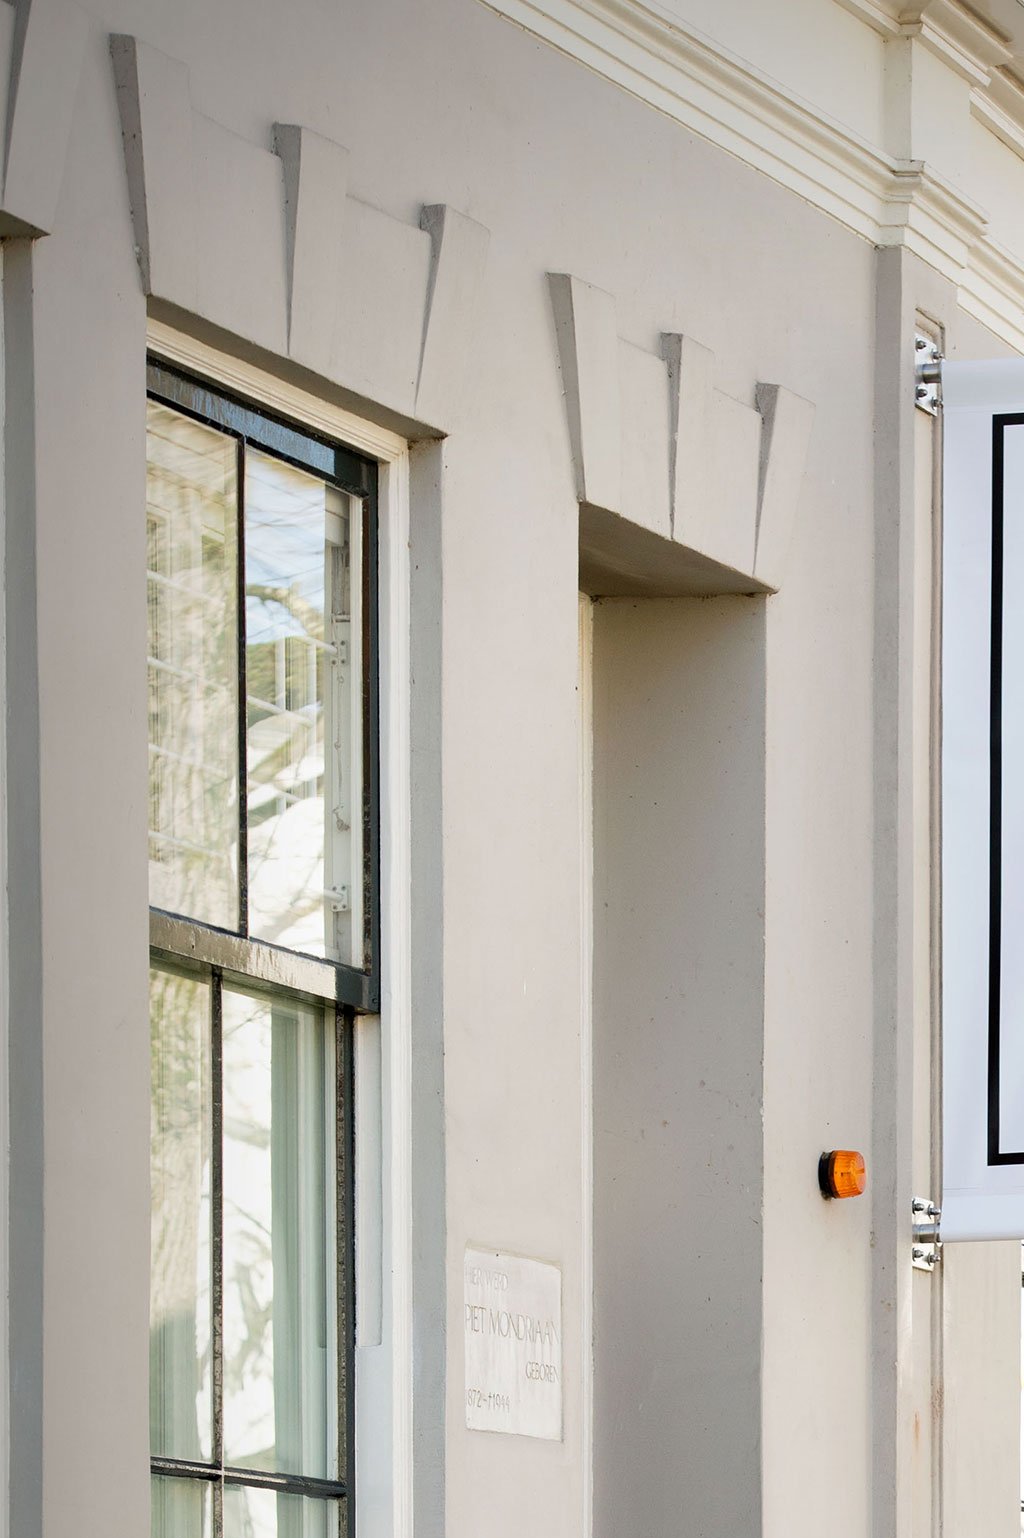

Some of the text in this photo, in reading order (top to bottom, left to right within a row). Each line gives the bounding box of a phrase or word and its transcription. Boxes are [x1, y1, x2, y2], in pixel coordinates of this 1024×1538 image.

[465, 1304, 560, 1345] PIET MONDRIAAN
[526, 1361, 560, 1383] GEBOREN
